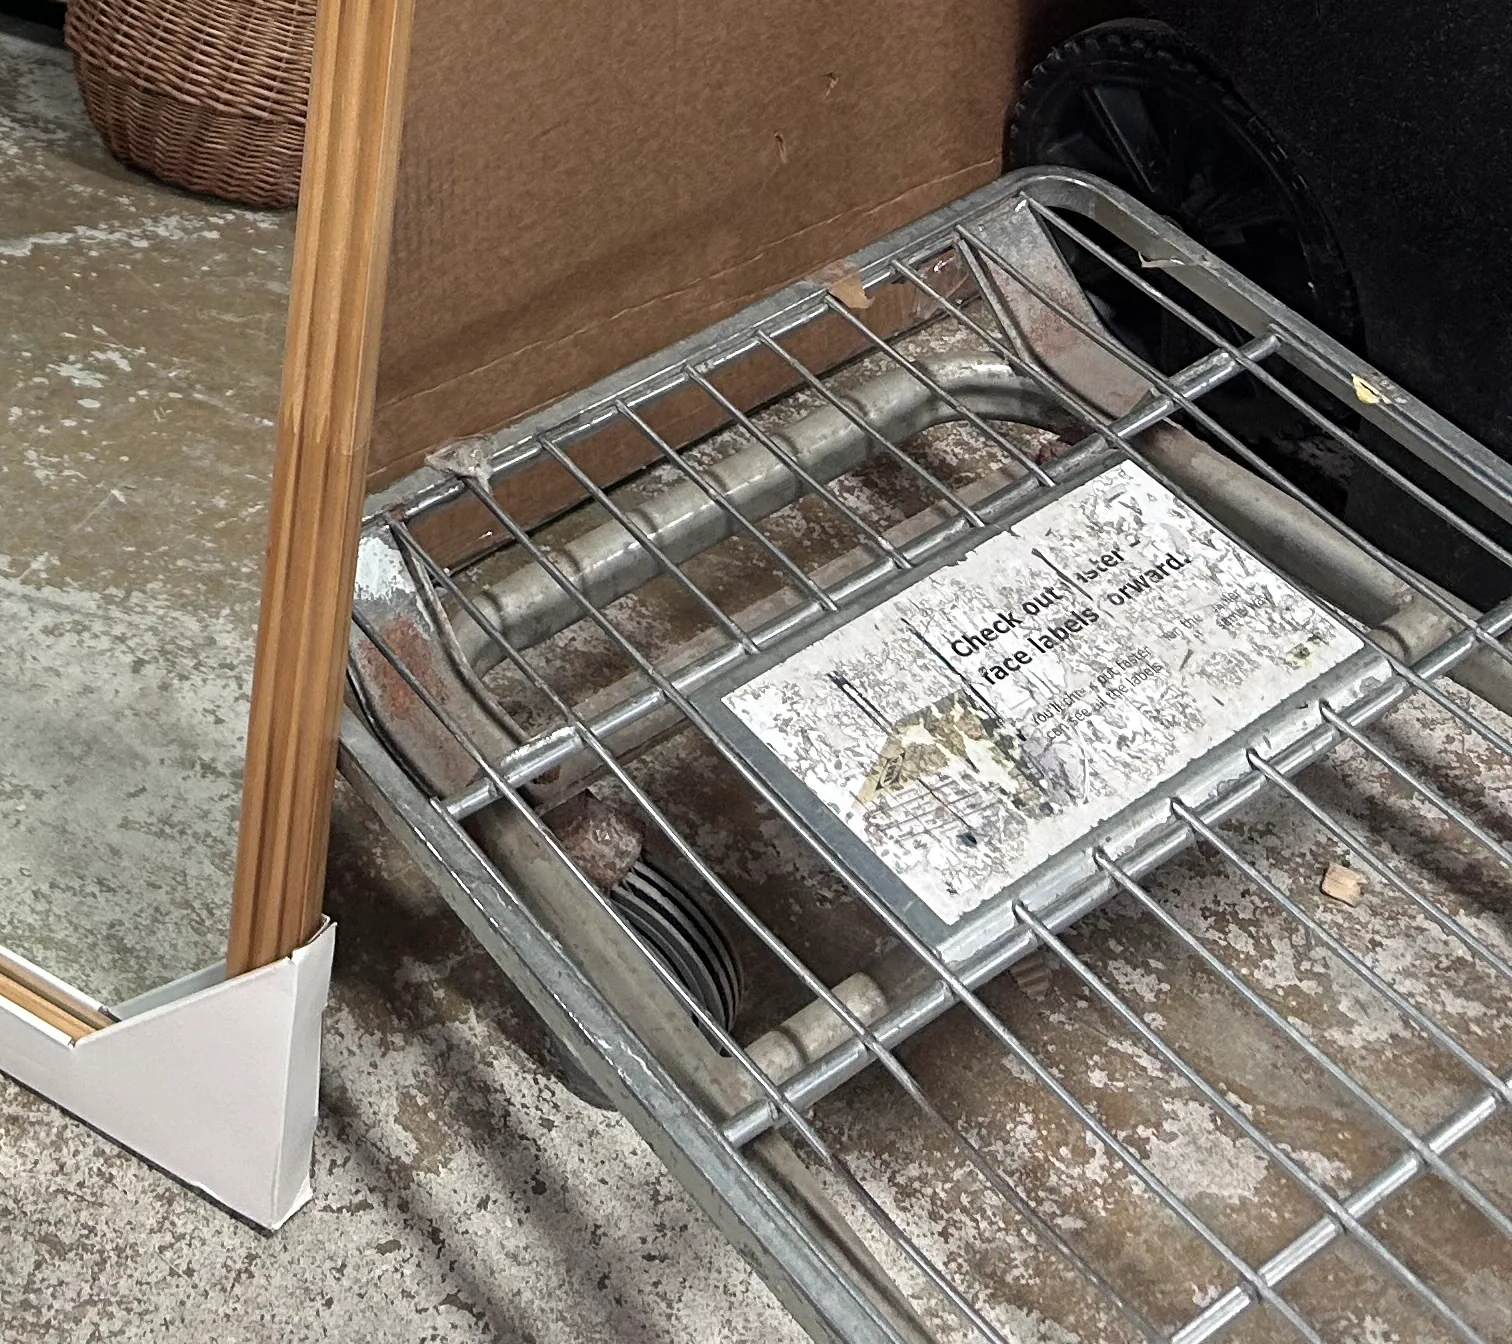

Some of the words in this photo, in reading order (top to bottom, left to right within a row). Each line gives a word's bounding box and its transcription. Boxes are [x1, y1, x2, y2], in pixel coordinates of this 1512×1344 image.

[951, 611, 1023, 657] Check
[1022, 586, 1064, 616] out
[1027, 607, 1100, 654] labels
[1106, 552, 1192, 606] orward.
